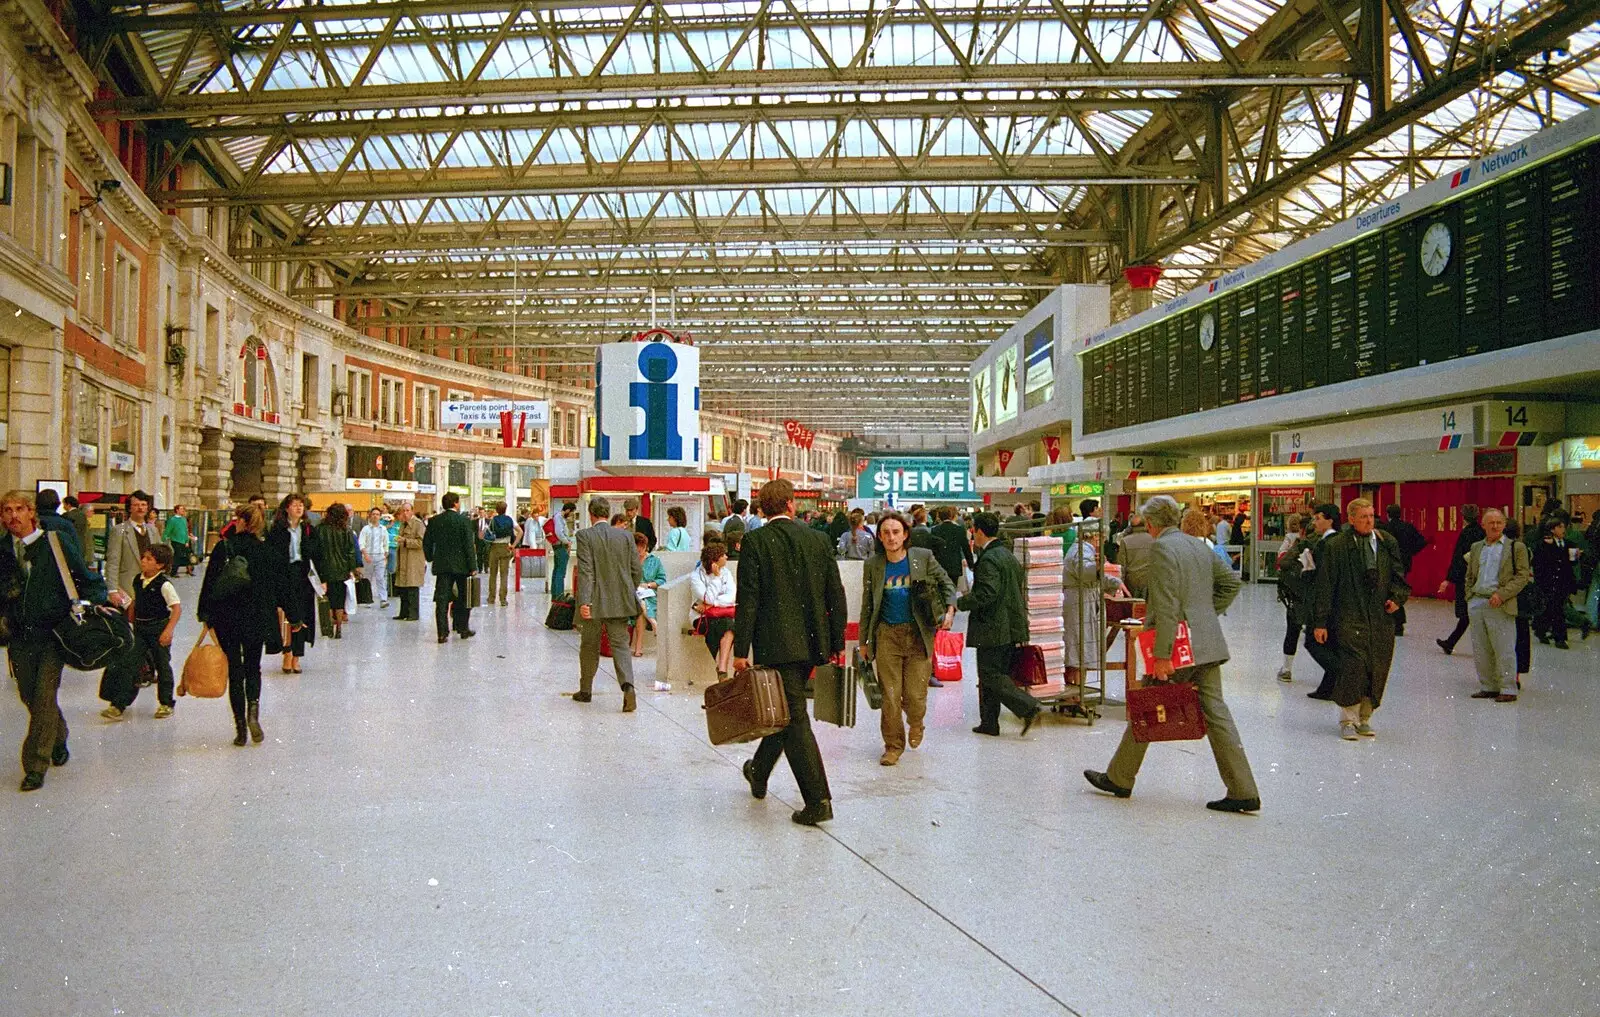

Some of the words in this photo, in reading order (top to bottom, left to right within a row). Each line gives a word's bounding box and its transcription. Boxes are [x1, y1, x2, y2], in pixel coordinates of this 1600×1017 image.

[1481, 144, 1528, 176] Network
[1356, 202, 1401, 230] Departures
[459, 403, 487, 411] Parcels
[512, 403, 535, 411] Buses
[460, 412, 479, 420] Taxis
[481, 412, 487, 420] &
[1442, 410, 1456, 431] 14
[1505, 405, 1528, 427] 14
[786, 422, 794, 431] C
[1051, 439, 1060, 451] A
[1291, 432, 1301, 449] 13
[1001, 452, 1009, 462] B
[1131, 457, 1143, 469] 12
